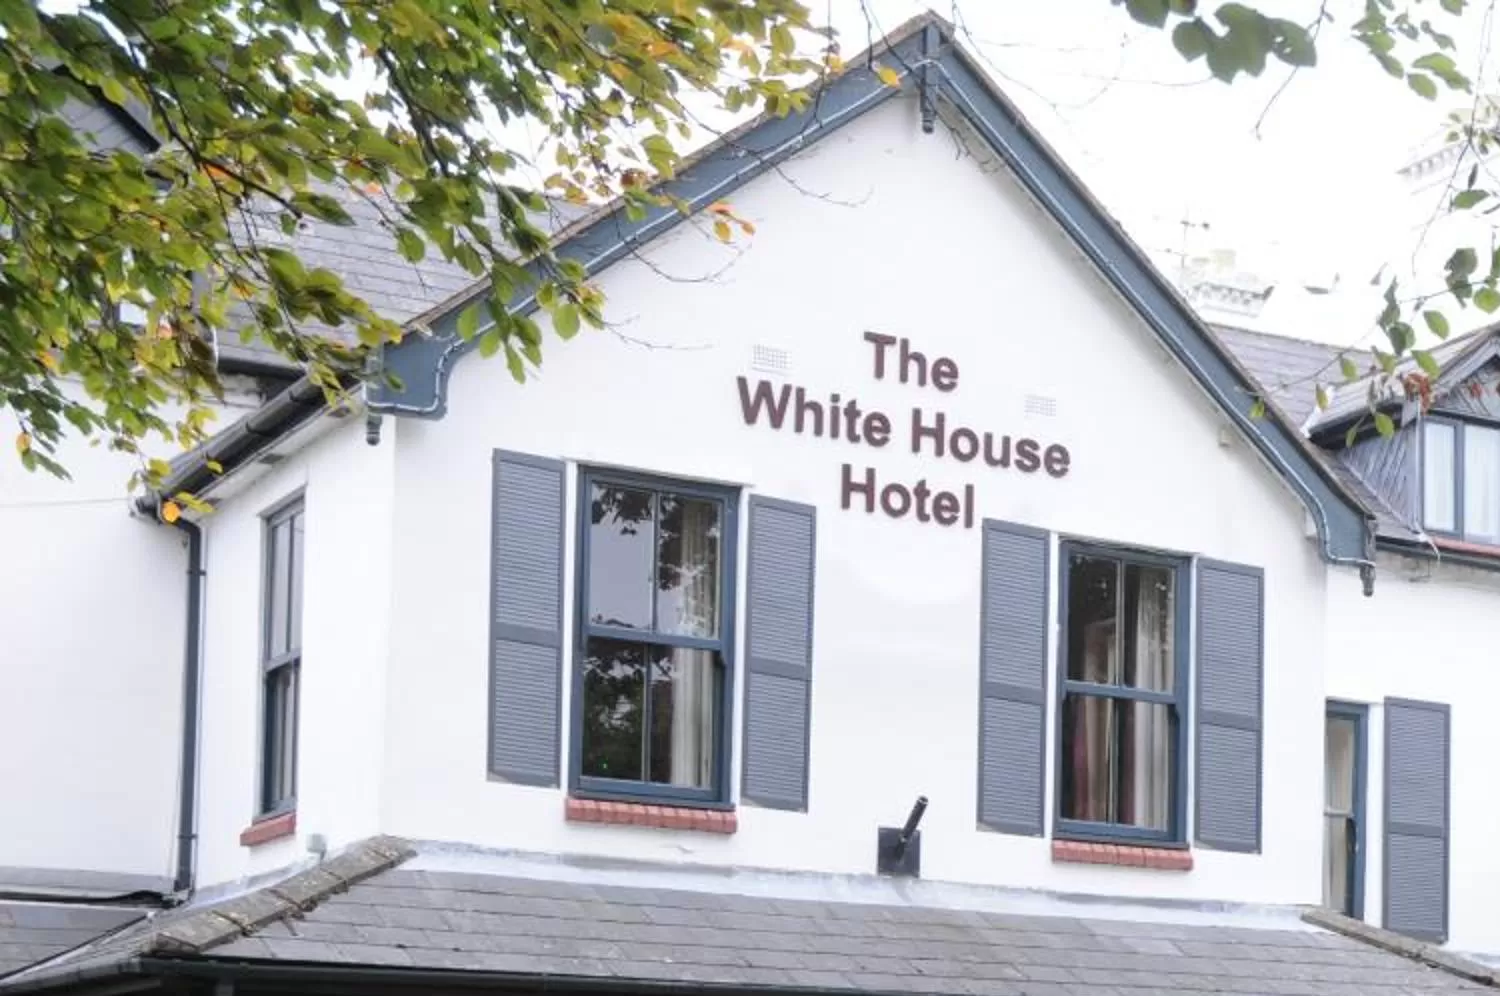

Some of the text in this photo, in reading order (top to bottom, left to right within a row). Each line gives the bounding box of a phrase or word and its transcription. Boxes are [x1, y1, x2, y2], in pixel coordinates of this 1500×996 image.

[863, 331, 959, 392] The
[736, 375, 1071, 478] White House
[841, 463, 974, 529] Hotel
